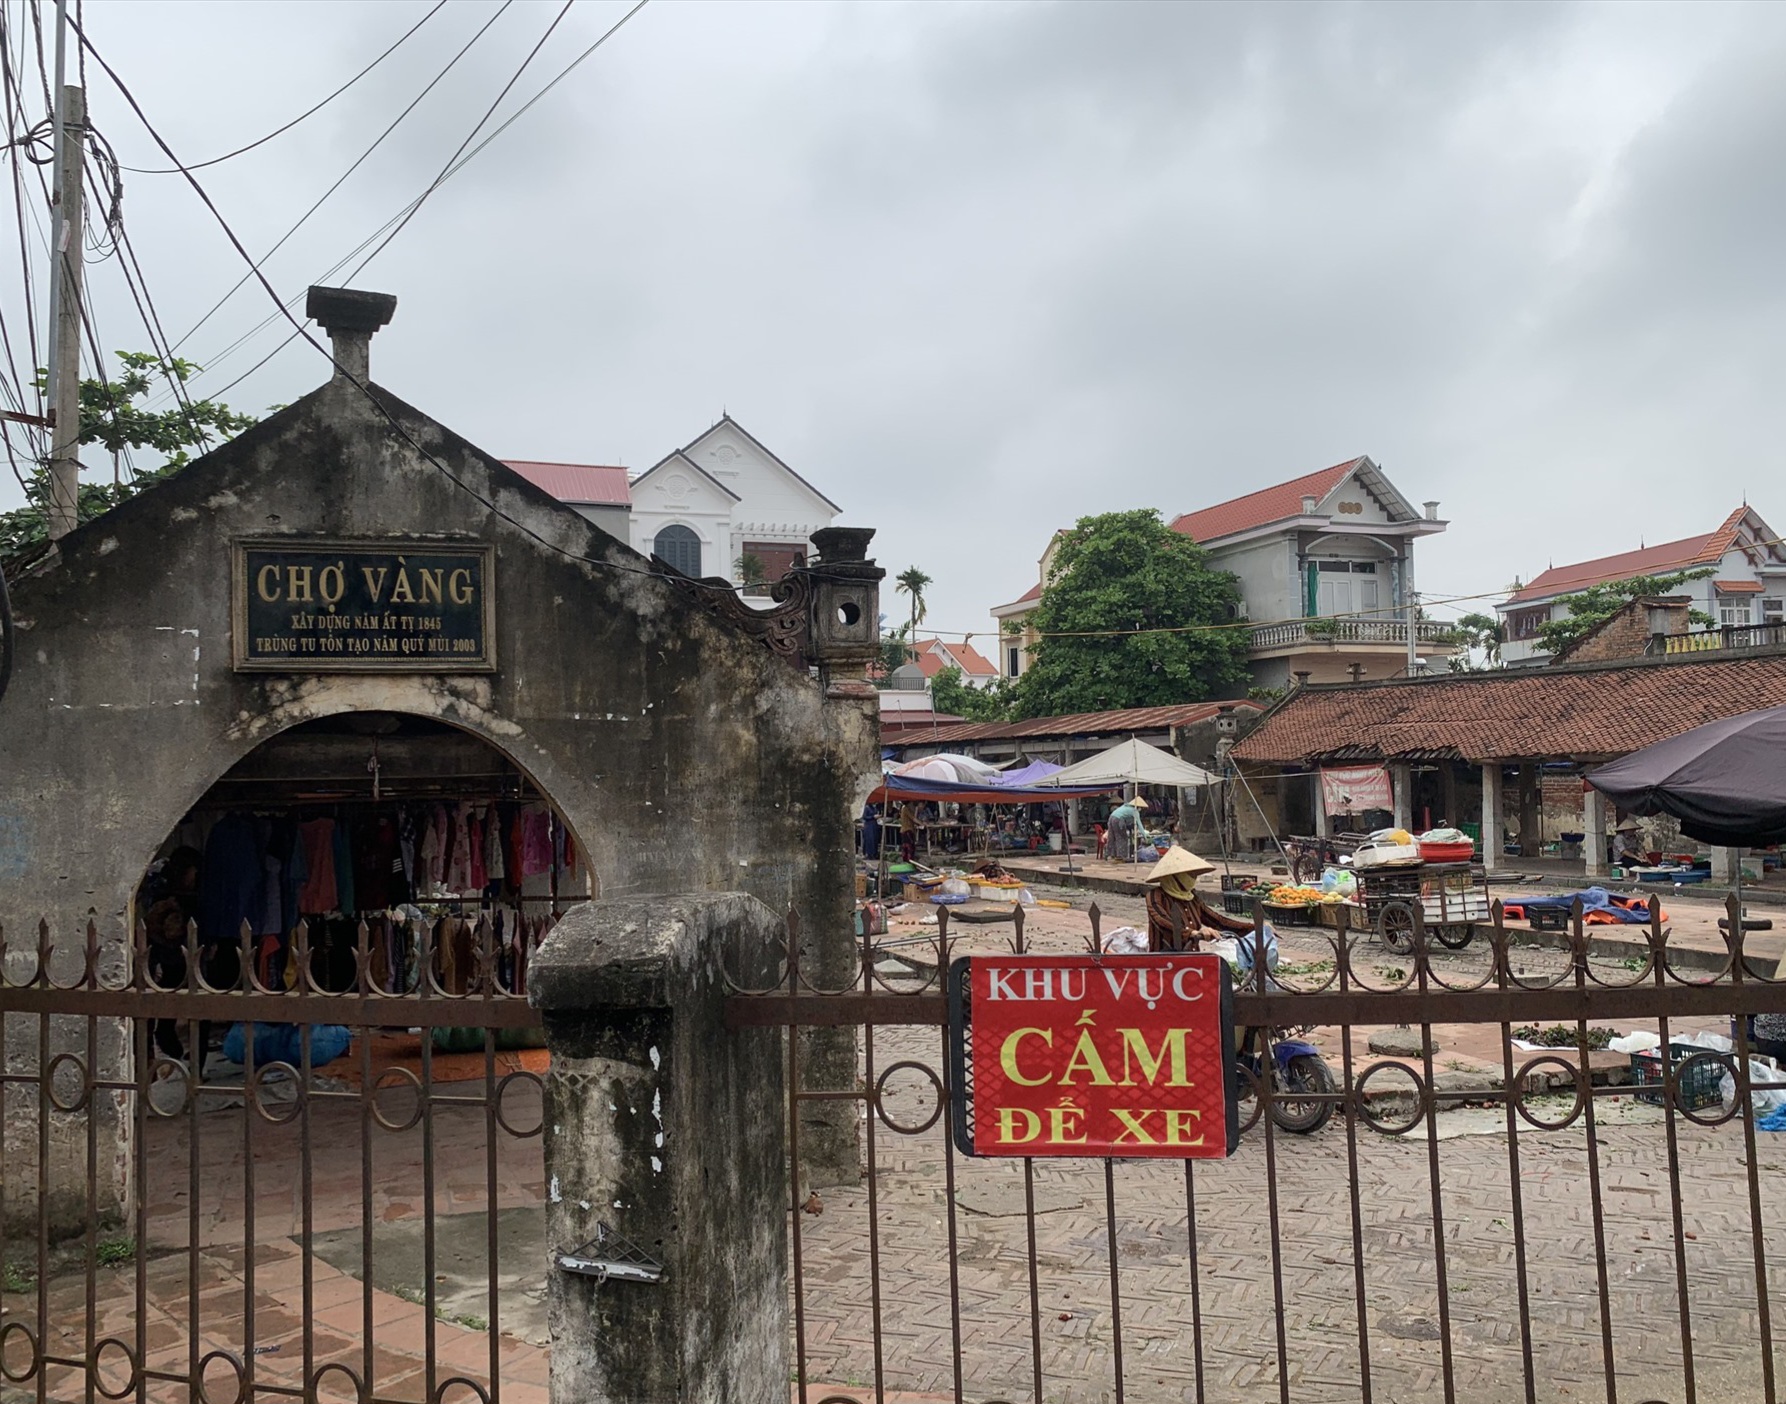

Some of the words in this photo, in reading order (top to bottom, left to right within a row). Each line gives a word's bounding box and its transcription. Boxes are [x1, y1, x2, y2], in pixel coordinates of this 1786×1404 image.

[256, 560, 345, 613] CHỢ
[361, 556, 474, 604] VÀNG
[256, 633, 297, 652] TRÙNG
[301, 638, 316, 652] TU
[320, 633, 343, 652] TÔN
[347, 638, 370, 655] TẠO
[373, 634, 398, 652] NĂM
[401, 634, 424, 654] QUÝ
[428, 634, 450, 652] MÙI
[453, 638, 475, 652] 2003
[291, 611, 314, 629] XÂY
[318, 614, 350, 633] DỰNG
[354, 612, 379, 630] NĂM
[382, 610, 397, 629] ẤT
[401, 616, 414, 633] TỴ
[418, 616, 442, 630] 1845
[985, 967, 1088, 1001] KHU
[1103, 962, 1204, 1011] VỰC
[999, 1009, 1195, 1088] CẤM
[994, 1096, 1088, 1144] ĐỂ
[1108, 1109, 1205, 1145] XE
